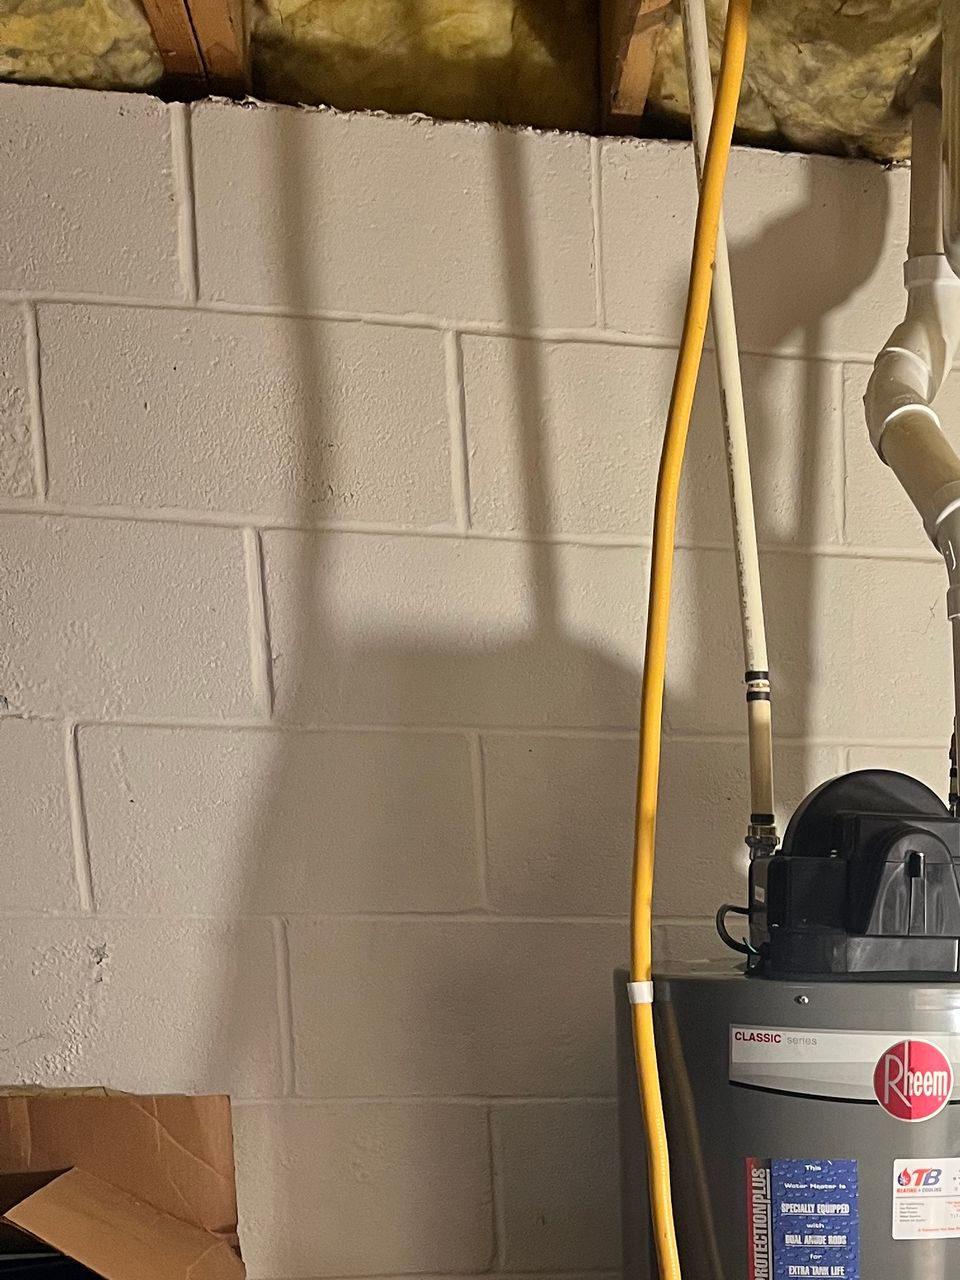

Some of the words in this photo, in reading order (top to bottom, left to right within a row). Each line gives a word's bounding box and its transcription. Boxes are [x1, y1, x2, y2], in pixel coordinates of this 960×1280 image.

[734, 1031, 782, 1044] CLASSIC
[786, 1036, 817, 1046] series
[884, 1039, 948, 1108] Rheem
[912, 1168, 943, 1186] TB
[781, 1203, 815, 1213] SPECIALLY
[817, 1203, 850, 1213] EQUIPPED
[784, 1234, 802, 1244] DUAL
[803, 1234, 827, 1245] ANODE
[828, 1235, 847, 1244] RODS
[788, 1265, 810, 1275] EXTRA
[811, 1265, 830, 1275] TANK
[831, 1265, 845, 1275] LIFE
